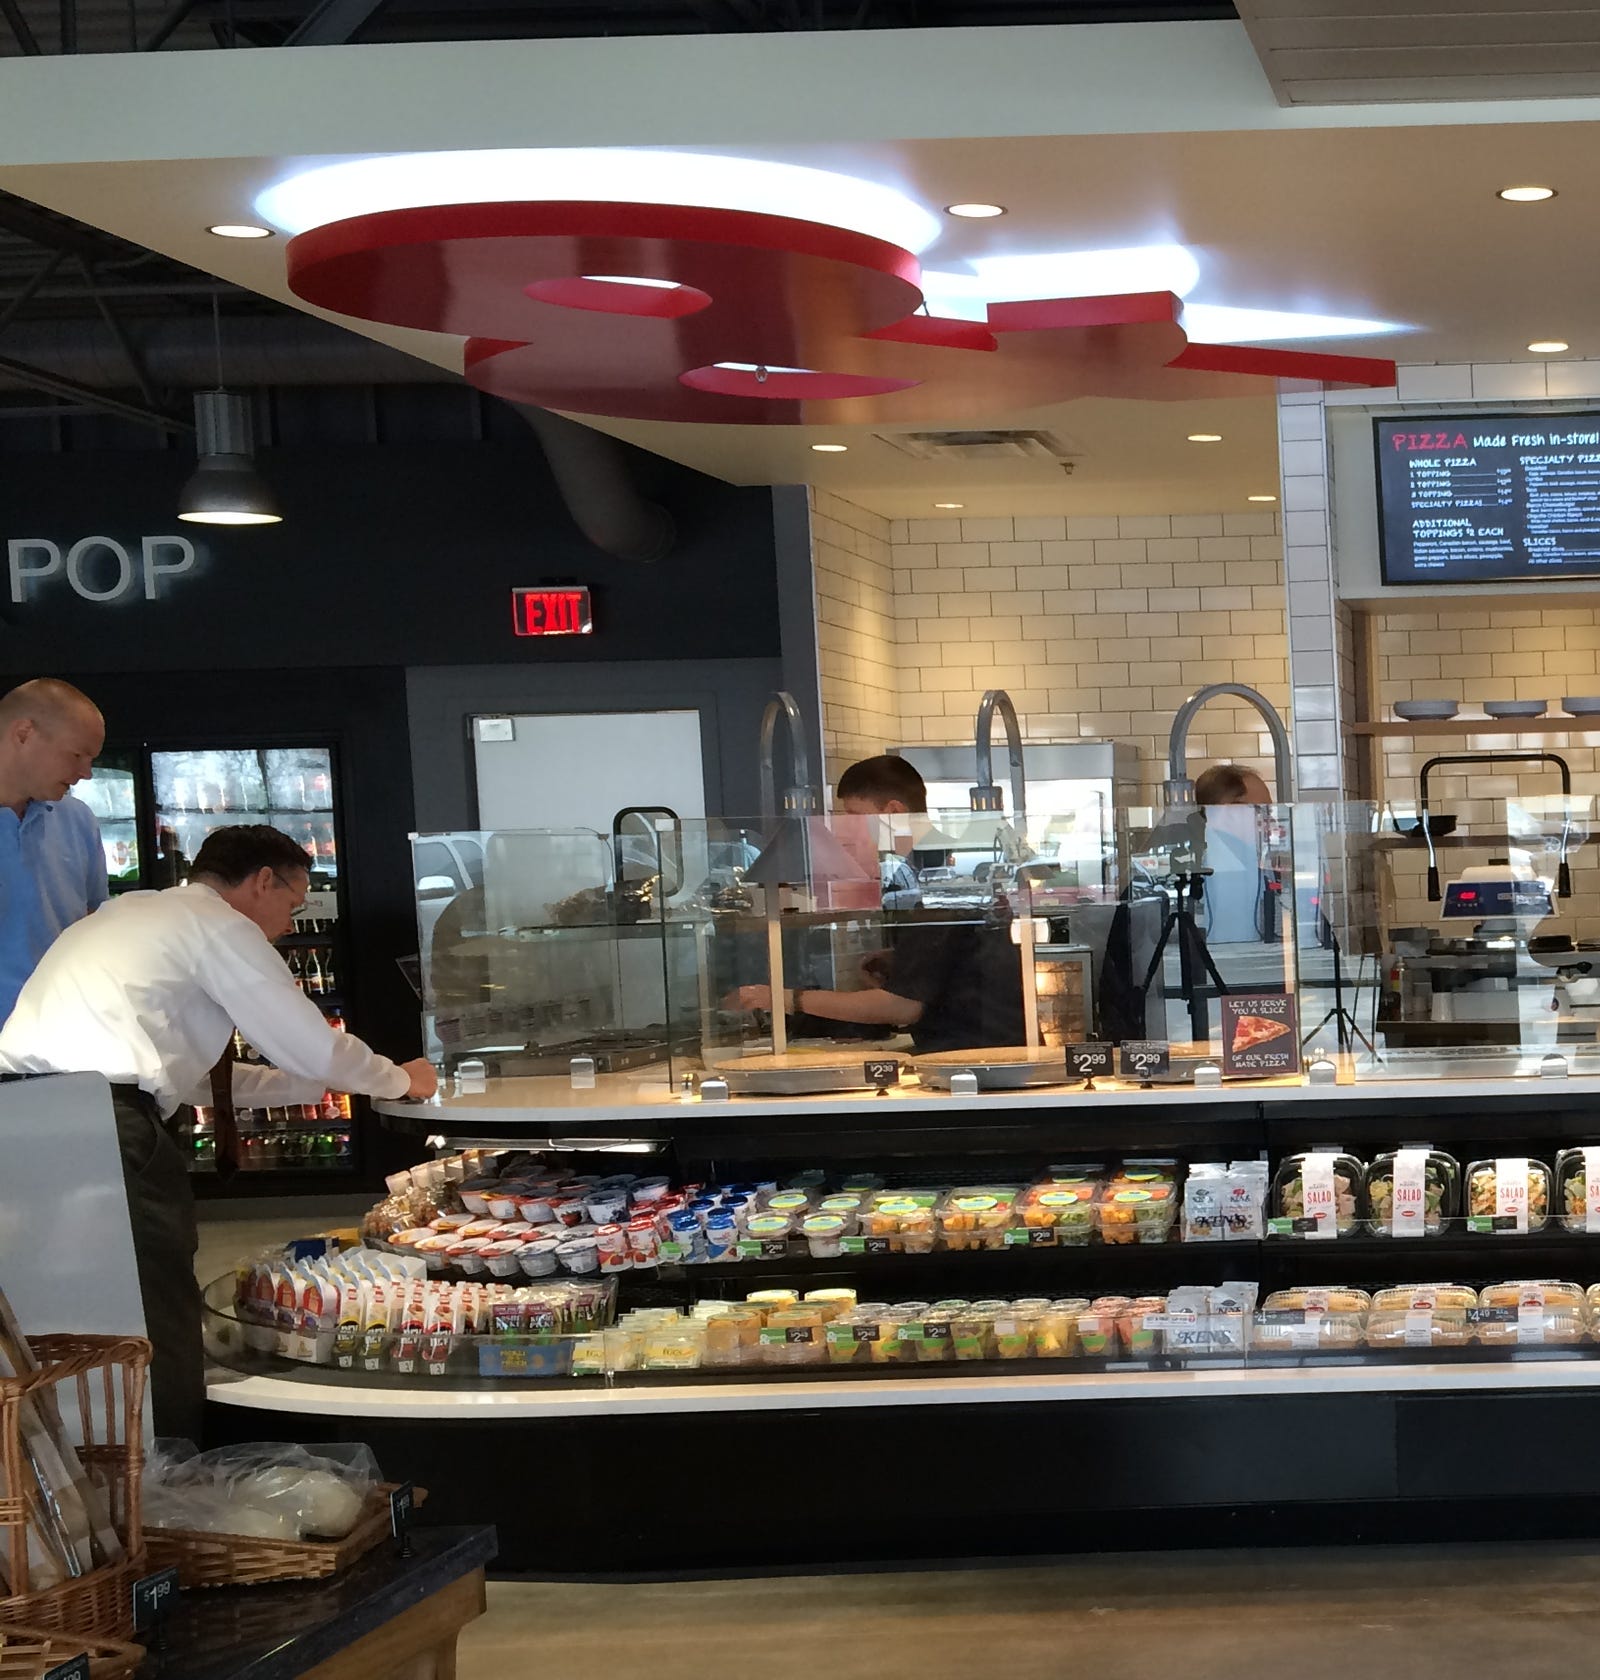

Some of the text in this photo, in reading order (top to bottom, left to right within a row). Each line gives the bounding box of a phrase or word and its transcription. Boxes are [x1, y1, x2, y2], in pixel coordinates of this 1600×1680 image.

[1393, 432, 1599, 451] PIZZA Made Fresh in-store!
[1410, 458, 1476, 468] WHOLE PIZZA
[1520, 455, 1574, 465] SPECIALTY
[1413, 518, 1471, 528] ADDITIONAL
[1413, 528, 1463, 537] TOPPINGS
[1478, 528, 1503, 536] EACH
[1523, 537, 1556, 546] SLICES
[8, 536, 194, 602] POP
[525, 594, 581, 633] EXIT
[1307, 1191, 1331, 1204] SALAD
[1397, 1189, 1421, 1201] SALAD
[1500, 1187, 1524, 1198] SALAD
